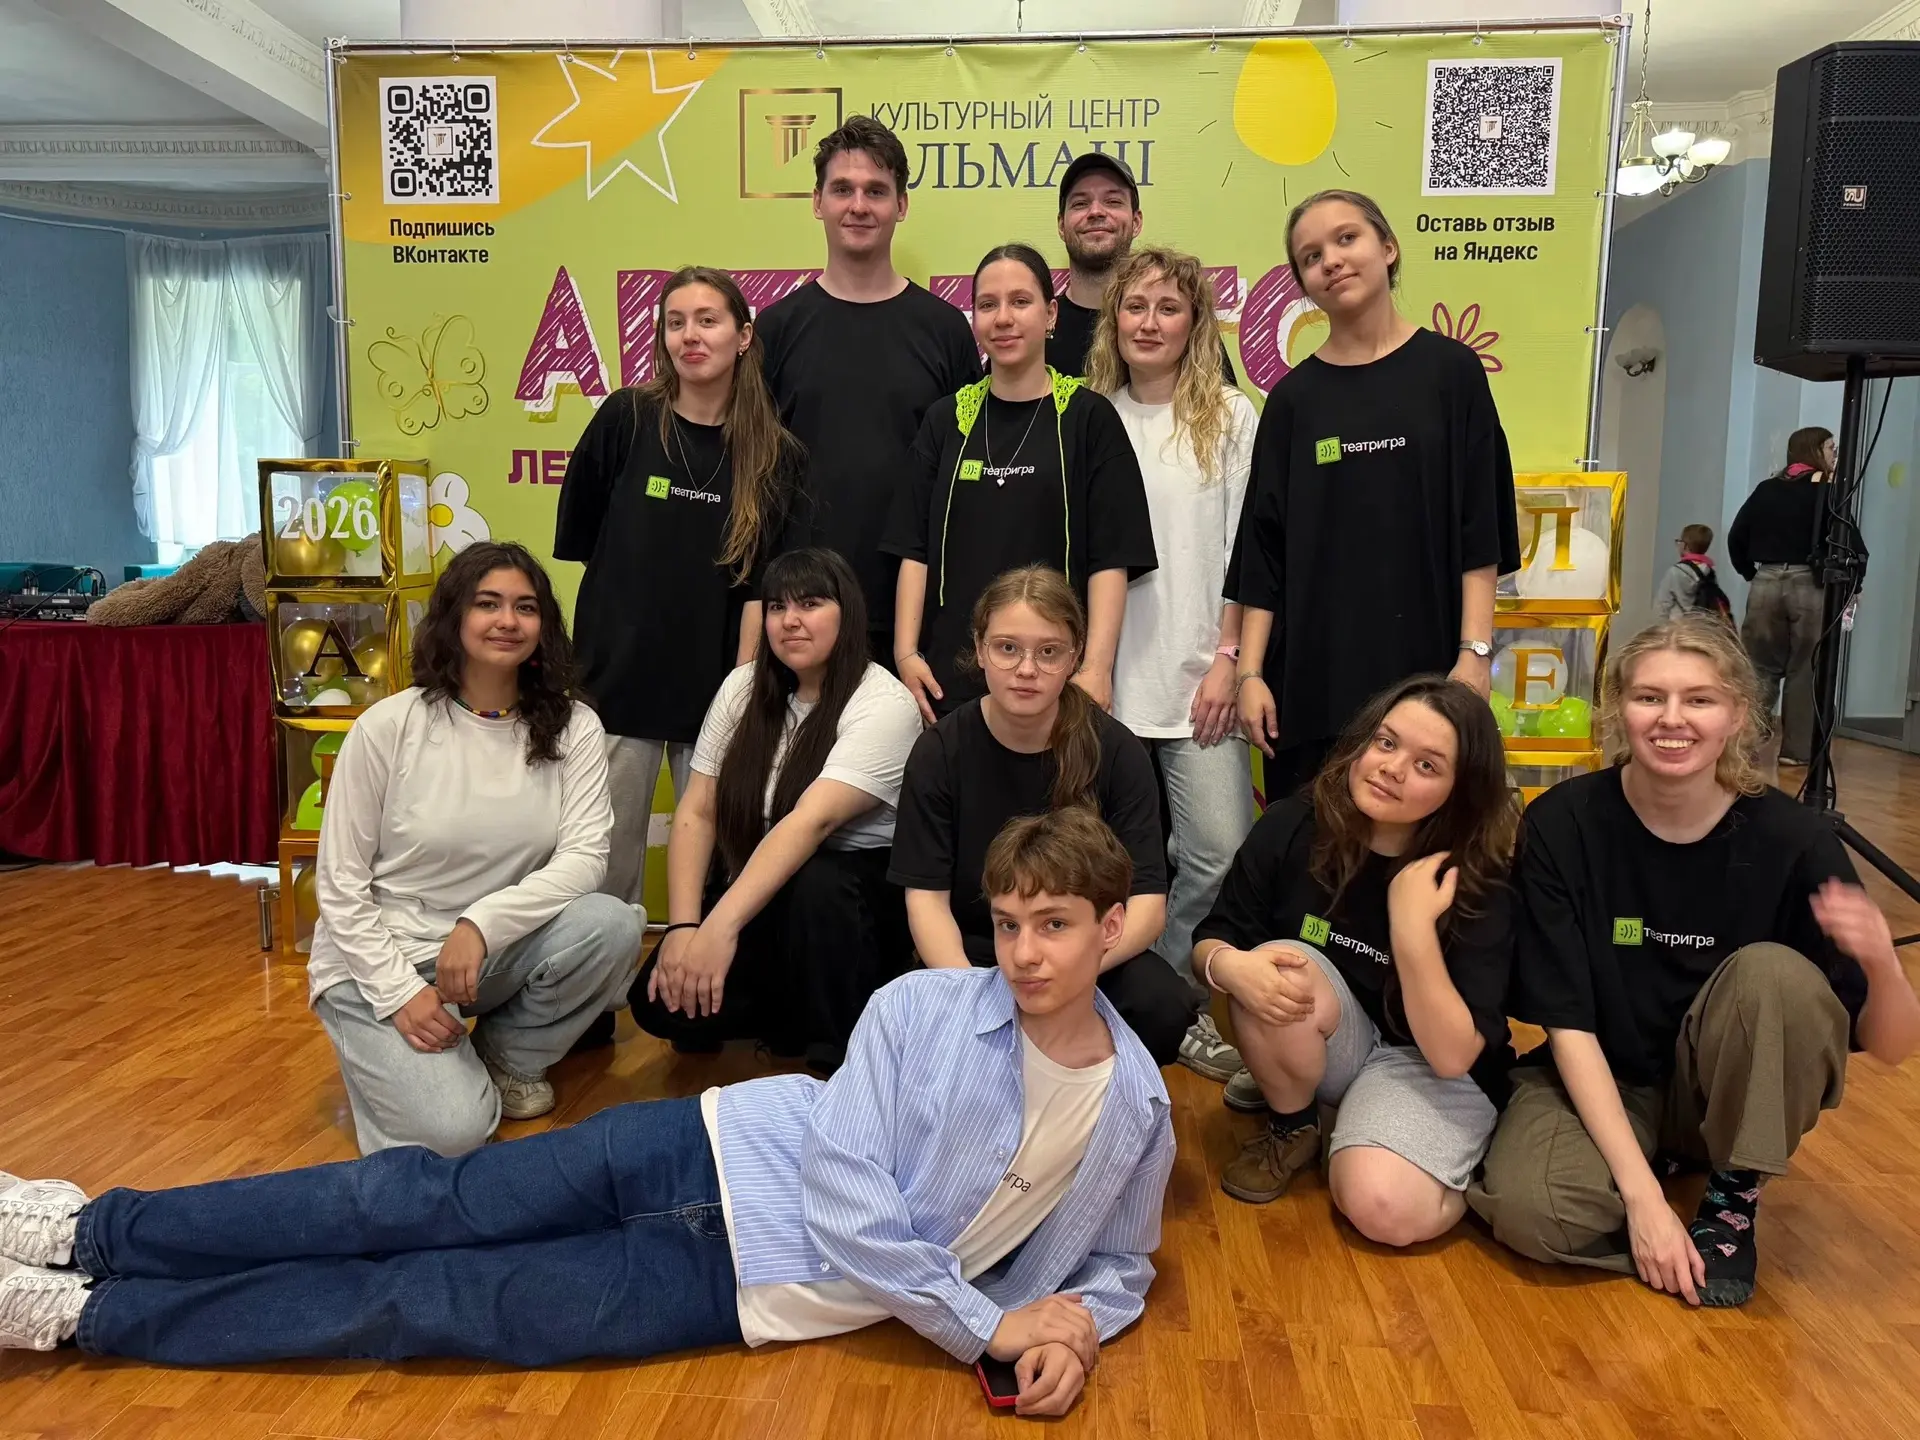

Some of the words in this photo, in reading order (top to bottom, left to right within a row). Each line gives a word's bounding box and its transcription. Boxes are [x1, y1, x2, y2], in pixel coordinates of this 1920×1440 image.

[871, 94, 1052, 131] КУЛЬТУРНЫЙ
[1069, 98, 1160, 134] ЦЕНТР
[390, 218, 495, 239] Подпишись
[1416, 213, 1487, 232] Оставь
[1493, 217, 1555, 232] отзыв
[393, 245, 489, 263] ВКонтакте
[1434, 246, 1458, 260] на
[1463, 242, 1538, 263] Яндекс
[1341, 436, 1406, 453] театригра
[983, 465, 1035, 478] театригра
[670, 486, 721, 503] театригра
[278, 496, 378, 541] 2026
[1329, 931, 1390, 965] театригра
[1643, 927, 1715, 949] театригра
